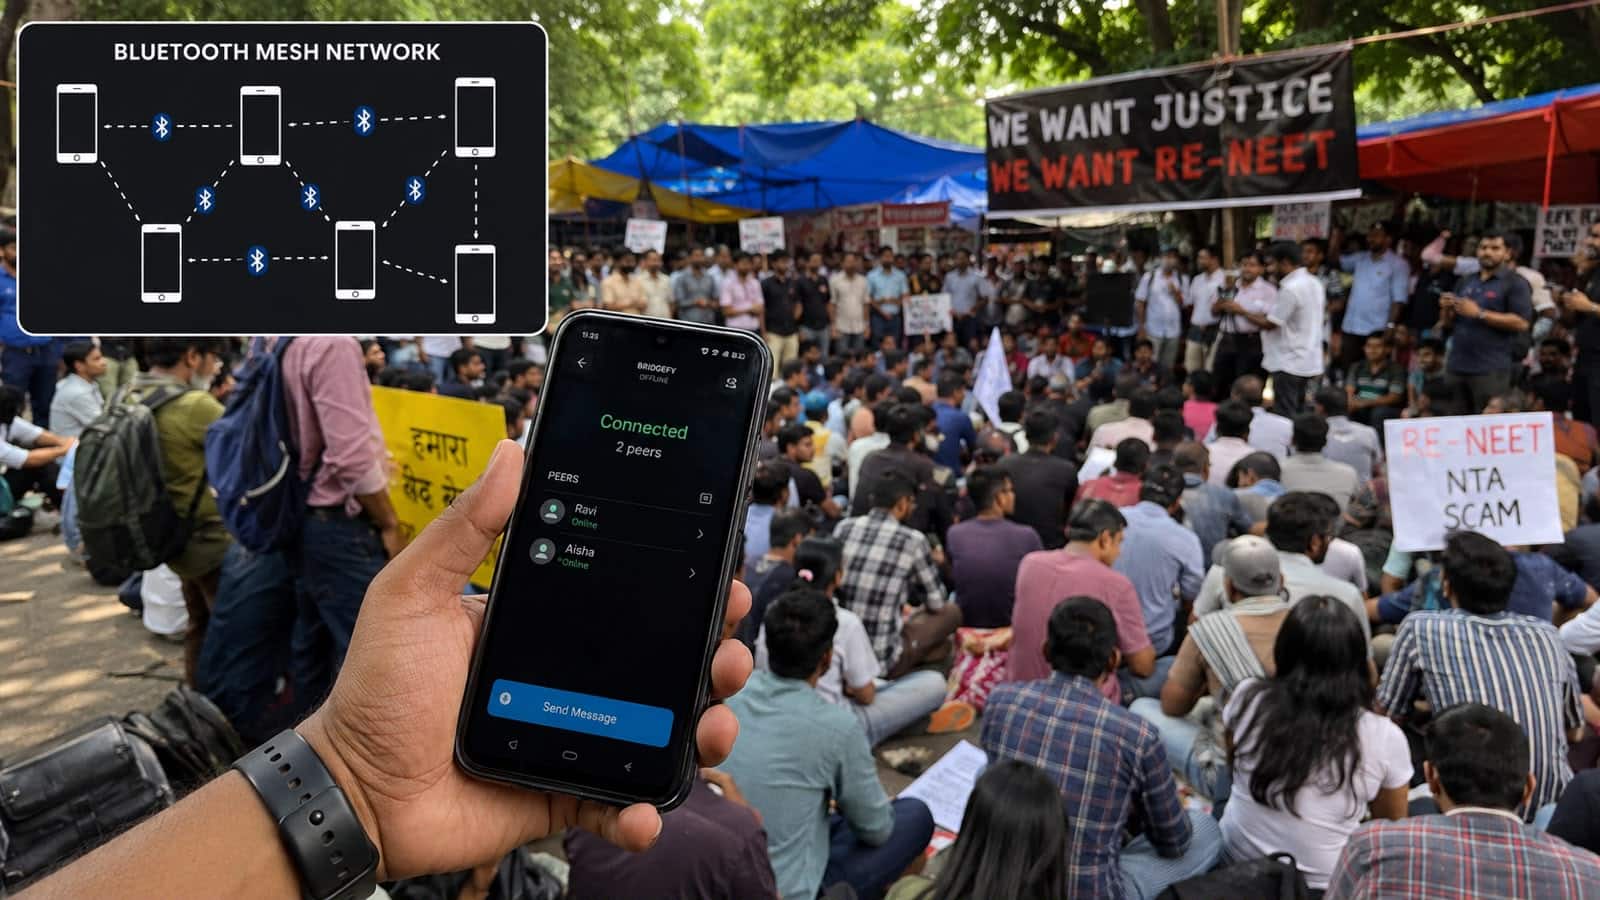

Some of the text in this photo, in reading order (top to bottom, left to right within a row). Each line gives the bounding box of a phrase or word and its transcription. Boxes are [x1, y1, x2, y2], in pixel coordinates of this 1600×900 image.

[989, 72, 1334, 148] WE WANT JUSTICE
[990, 130, 1336, 193] WE WANT RE-NEET
[637, 361, 677, 375] BRIDGEFY
[639, 373, 669, 385] OFFLINE
[600, 414, 689, 440] Connected
[615, 441, 662, 459] 2 peers
[1402, 423, 1546, 459] RE-NEET
[548, 470, 580, 484] PEERS
[1447, 466, 1505, 494] NTA
[575, 503, 598, 516] Ravi
[1445, 499, 1521, 531] SCAM
[571, 517, 598, 529] Online
[565, 543, 595, 558] Aisha
[561, 558, 589, 570] Online
[543, 701, 617, 725] Send Message
